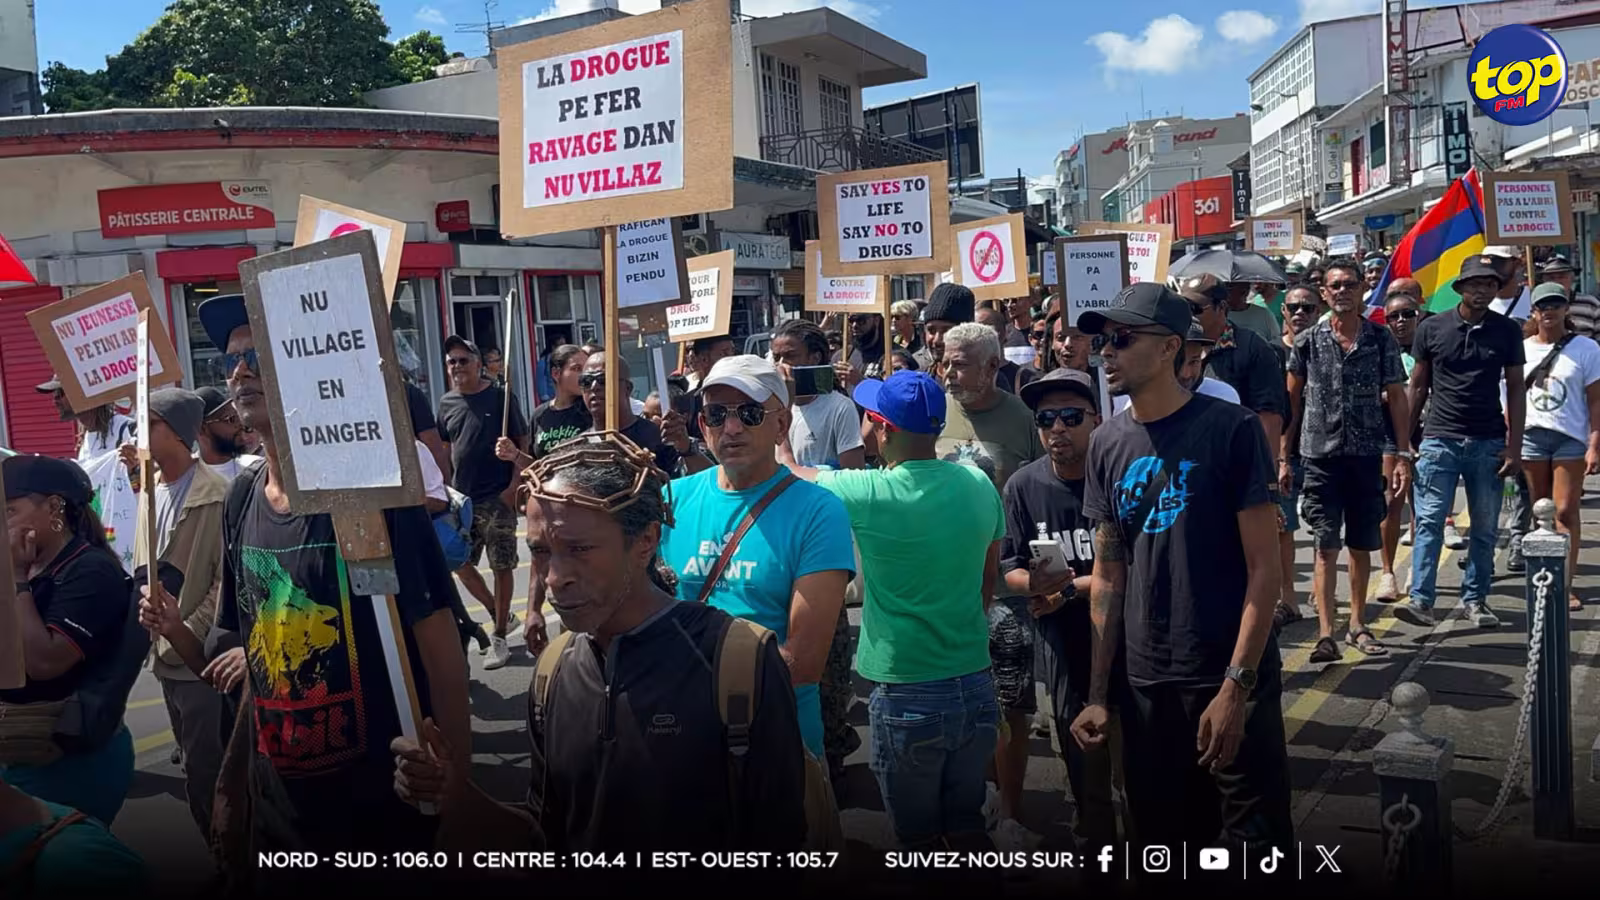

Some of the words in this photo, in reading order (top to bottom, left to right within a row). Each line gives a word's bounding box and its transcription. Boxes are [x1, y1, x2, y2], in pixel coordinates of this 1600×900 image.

[537, 63, 565, 89] LA
[570, 40, 670, 82] DROGUE
[559, 96, 588, 123] PE
[594, 86, 641, 116] FER
[528, 129, 617, 164] RAVAGE
[624, 120, 676, 149] DAN
[1446, 103, 1467, 179] TIMOL
[545, 174, 574, 199] NU
[578, 161, 662, 194] VILLAZ
[840, 184, 869, 199] SAY
[871, 181, 900, 196] YES
[904, 178, 925, 192] TO
[1497, 184, 1551, 193] PERSONNES
[867, 202, 904, 217] LIFE
[1194, 197, 1220, 215] 361
[1497, 198, 1514, 206] PAS
[1515, 198, 1521, 206] A
[108, 210, 180, 228] PÂTISSERIE
[183, 207, 254, 223] CENTRALE
[1509, 210, 1547, 219] CONTRE
[842, 226, 871, 240] SAY
[874, 224, 898, 237] NO
[902, 221, 923, 235] TO
[1503, 224, 1515, 232] LA
[1517, 223, 1555, 232] DROGUE
[629, 233, 668, 247] DROGUE
[1147, 234, 1157, 242] PA
[627, 251, 659, 264] BIZIN
[737, 243, 788, 259] AURATECH
[859, 243, 913, 259] DRUGS
[1070, 251, 1115, 259] PERSONNE
[626, 269, 666, 283] PENDU
[1086, 266, 1100, 275] PA
[830, 279, 865, 288] CONTRE
[1090, 283, 1098, 291] A
[300, 290, 329, 314] NU
[823, 291, 834, 299] LA
[670, 303, 701, 315] DRUGS
[55, 321, 75, 340] NU
[76, 299, 137, 336] JEUNESSE
[682, 315, 710, 327] THEM
[74, 343, 95, 361] PE
[95, 332, 121, 356] FINI
[282, 329, 366, 359] VILLAGE
[84, 369, 102, 387] LA
[318, 378, 345, 400] EN
[300, 420, 383, 446] DANGER
[682, 556, 758, 579] AVNT
